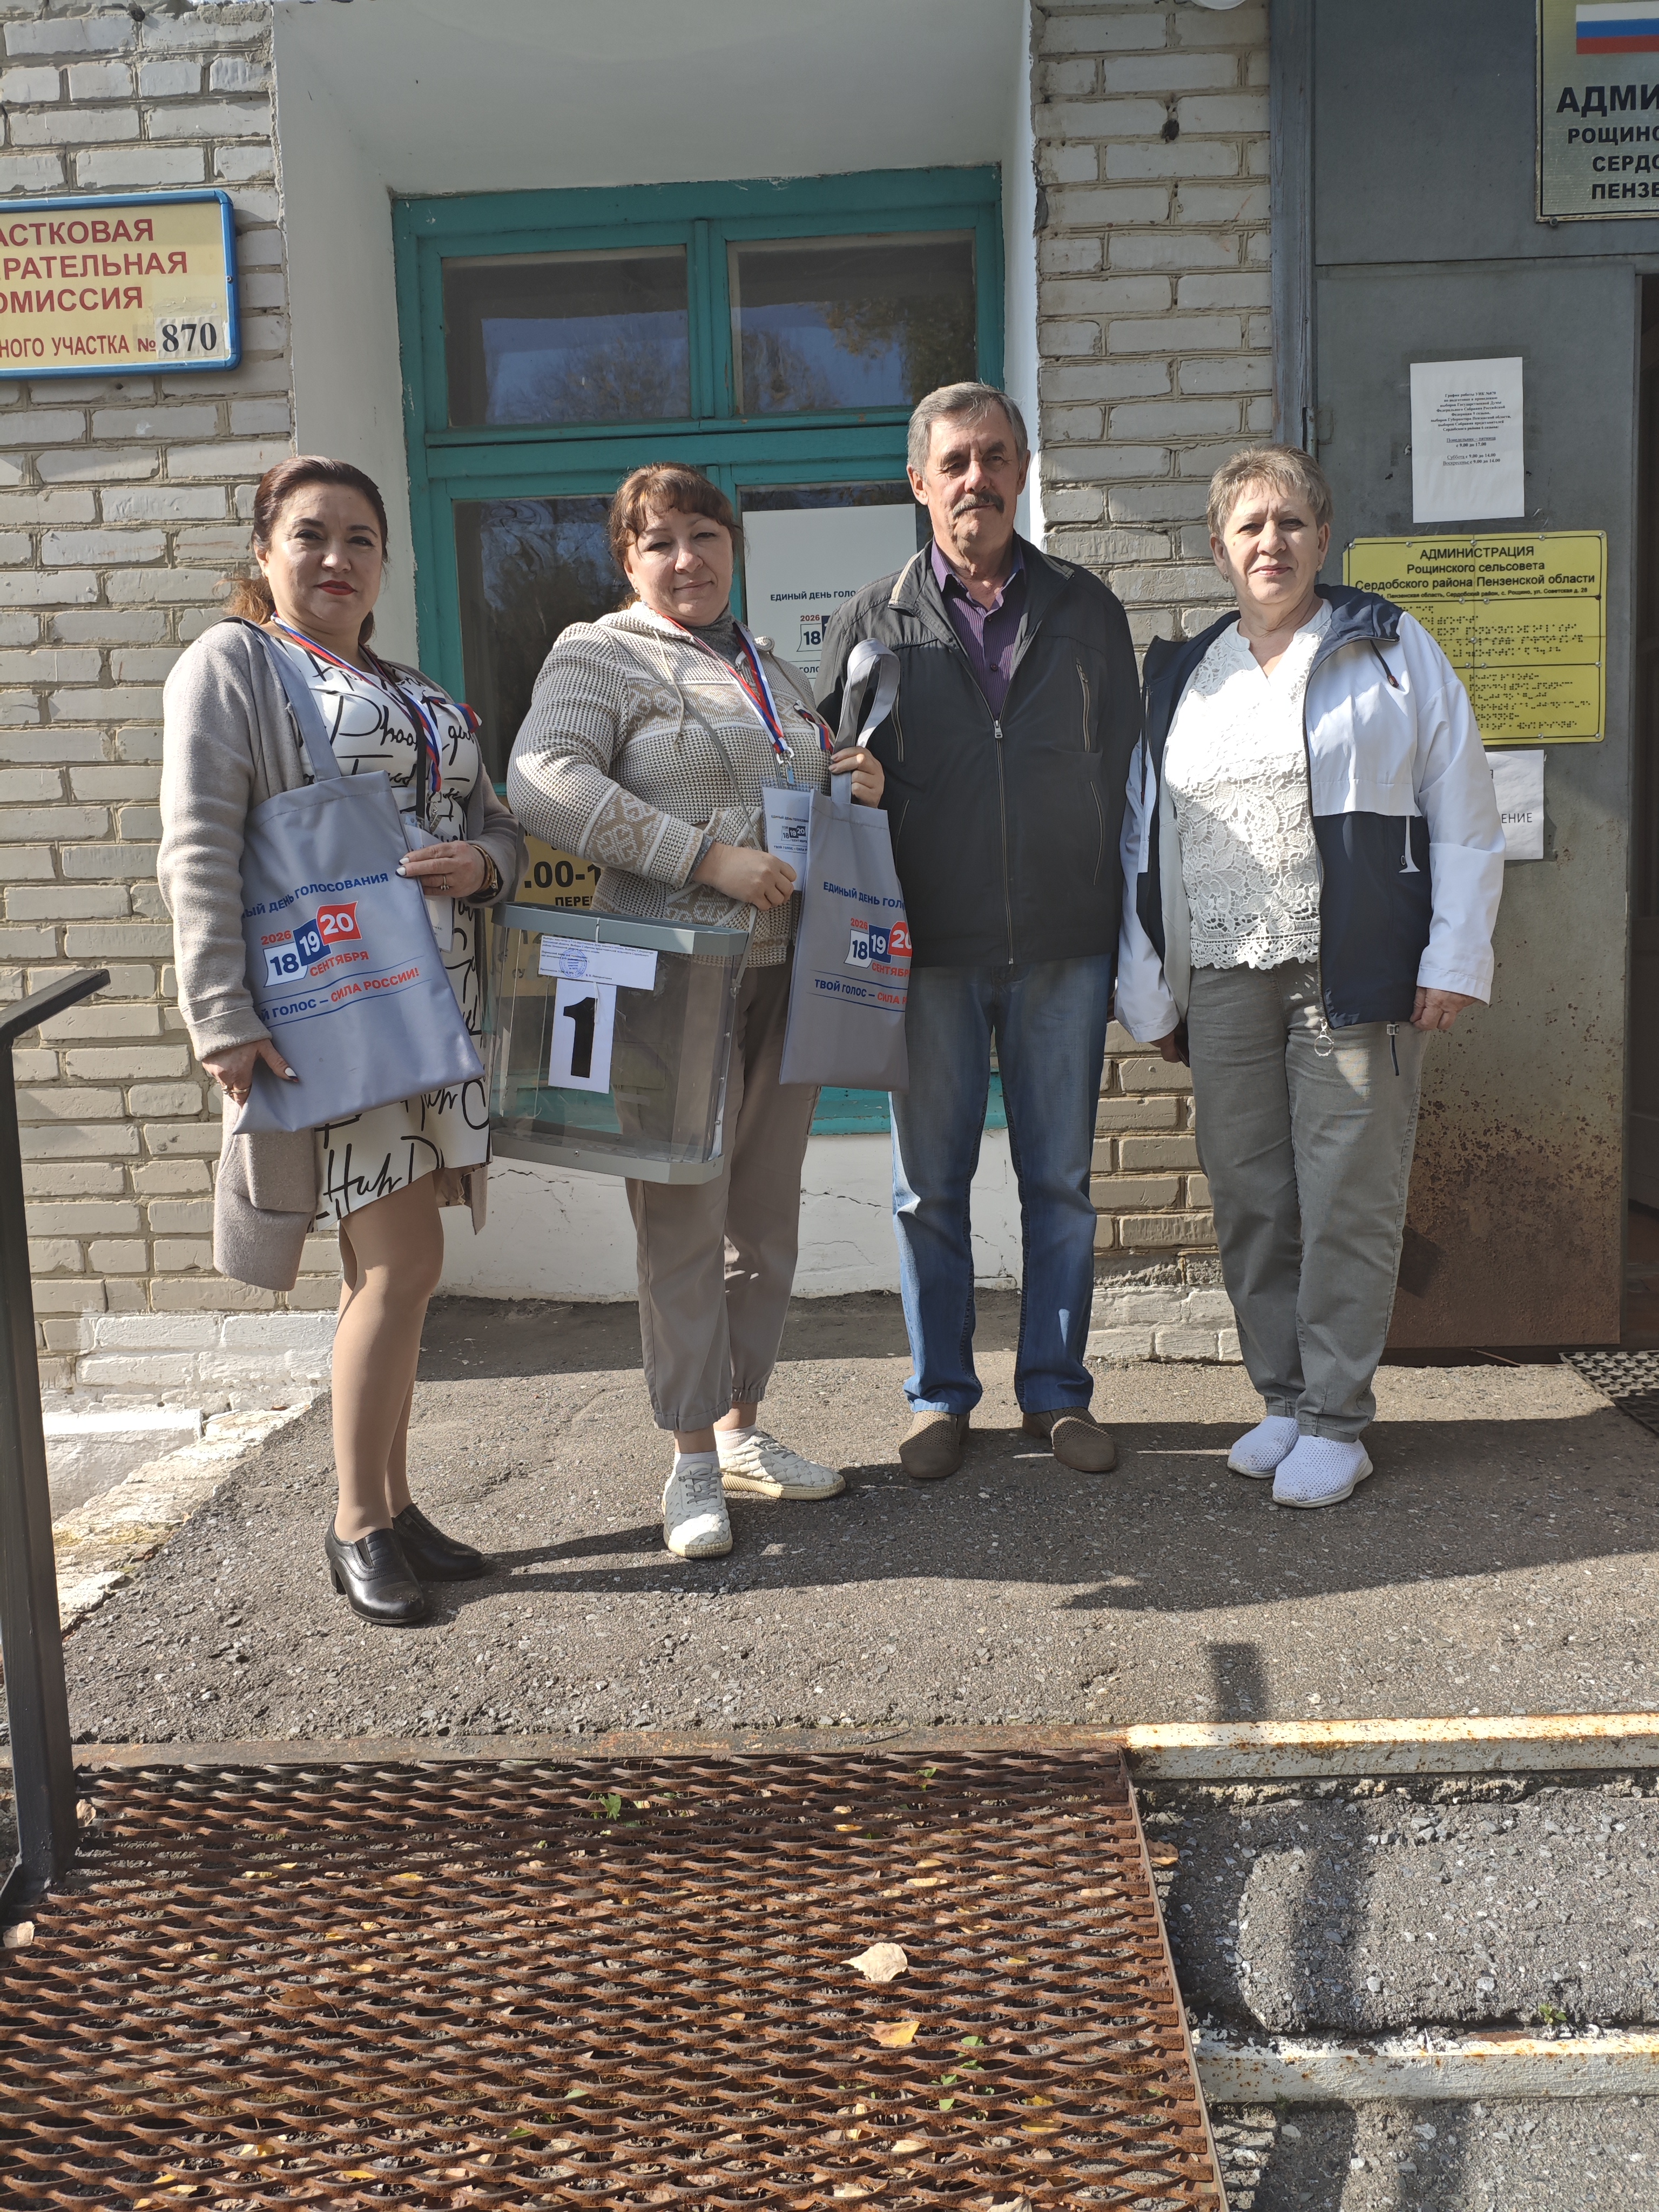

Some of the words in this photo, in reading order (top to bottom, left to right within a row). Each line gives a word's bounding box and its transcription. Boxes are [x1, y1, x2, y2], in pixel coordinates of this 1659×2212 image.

[51, 335, 130, 356] УЧАСТКА
[138, 338, 156, 352] №
[162, 322, 217, 352] 870
[1420, 545, 1534, 561] АДМИНИСТРАЦИЯ
[1407, 564, 1475, 575] Рощинского
[1479, 561, 1545, 572] сельсовета
[1355, 579, 1429, 591] Сердобского
[1432, 576, 1473, 589] района
[1476, 574, 1545, 587] Пензенской
[1548, 572, 1595, 584] области
[770, 591, 807, 602] ЕДИНЫЙ
[809, 592, 832, 600] ДЕНЬ
[1501, 813, 1533, 824] ЕНИЕ
[269, 894, 294, 913] ДЕНЬ
[294, 873, 389, 899] ГОЛОСОВАНИЯ
[555, 896, 593, 907] ПЕРЕ
[824, 881, 857, 899] ЕДИНЫЙ
[859, 892, 880, 905] ДЕНЬ
[851, 918, 868, 930] 2026
[261, 930, 292, 945] 2026
[270, 953, 299, 976] 18
[299, 931, 320, 956] 19
[320, 913, 354, 935] 20
[853, 940, 867, 960] 18
[871, 934, 886, 954] 19
[310, 951, 369, 976] СЕНТЯБРЯ
[272, 999, 316, 1017] ГОЛОС
[331, 983, 362, 1002] СИЛА
[363, 967, 420, 990] РОССИИ!
[815, 979, 840, 992] ТВОЙ
[841, 984, 867, 997] ГОЛОС
[877, 992, 900, 1004] СИЛА
[563, 997, 598, 1078] 1
